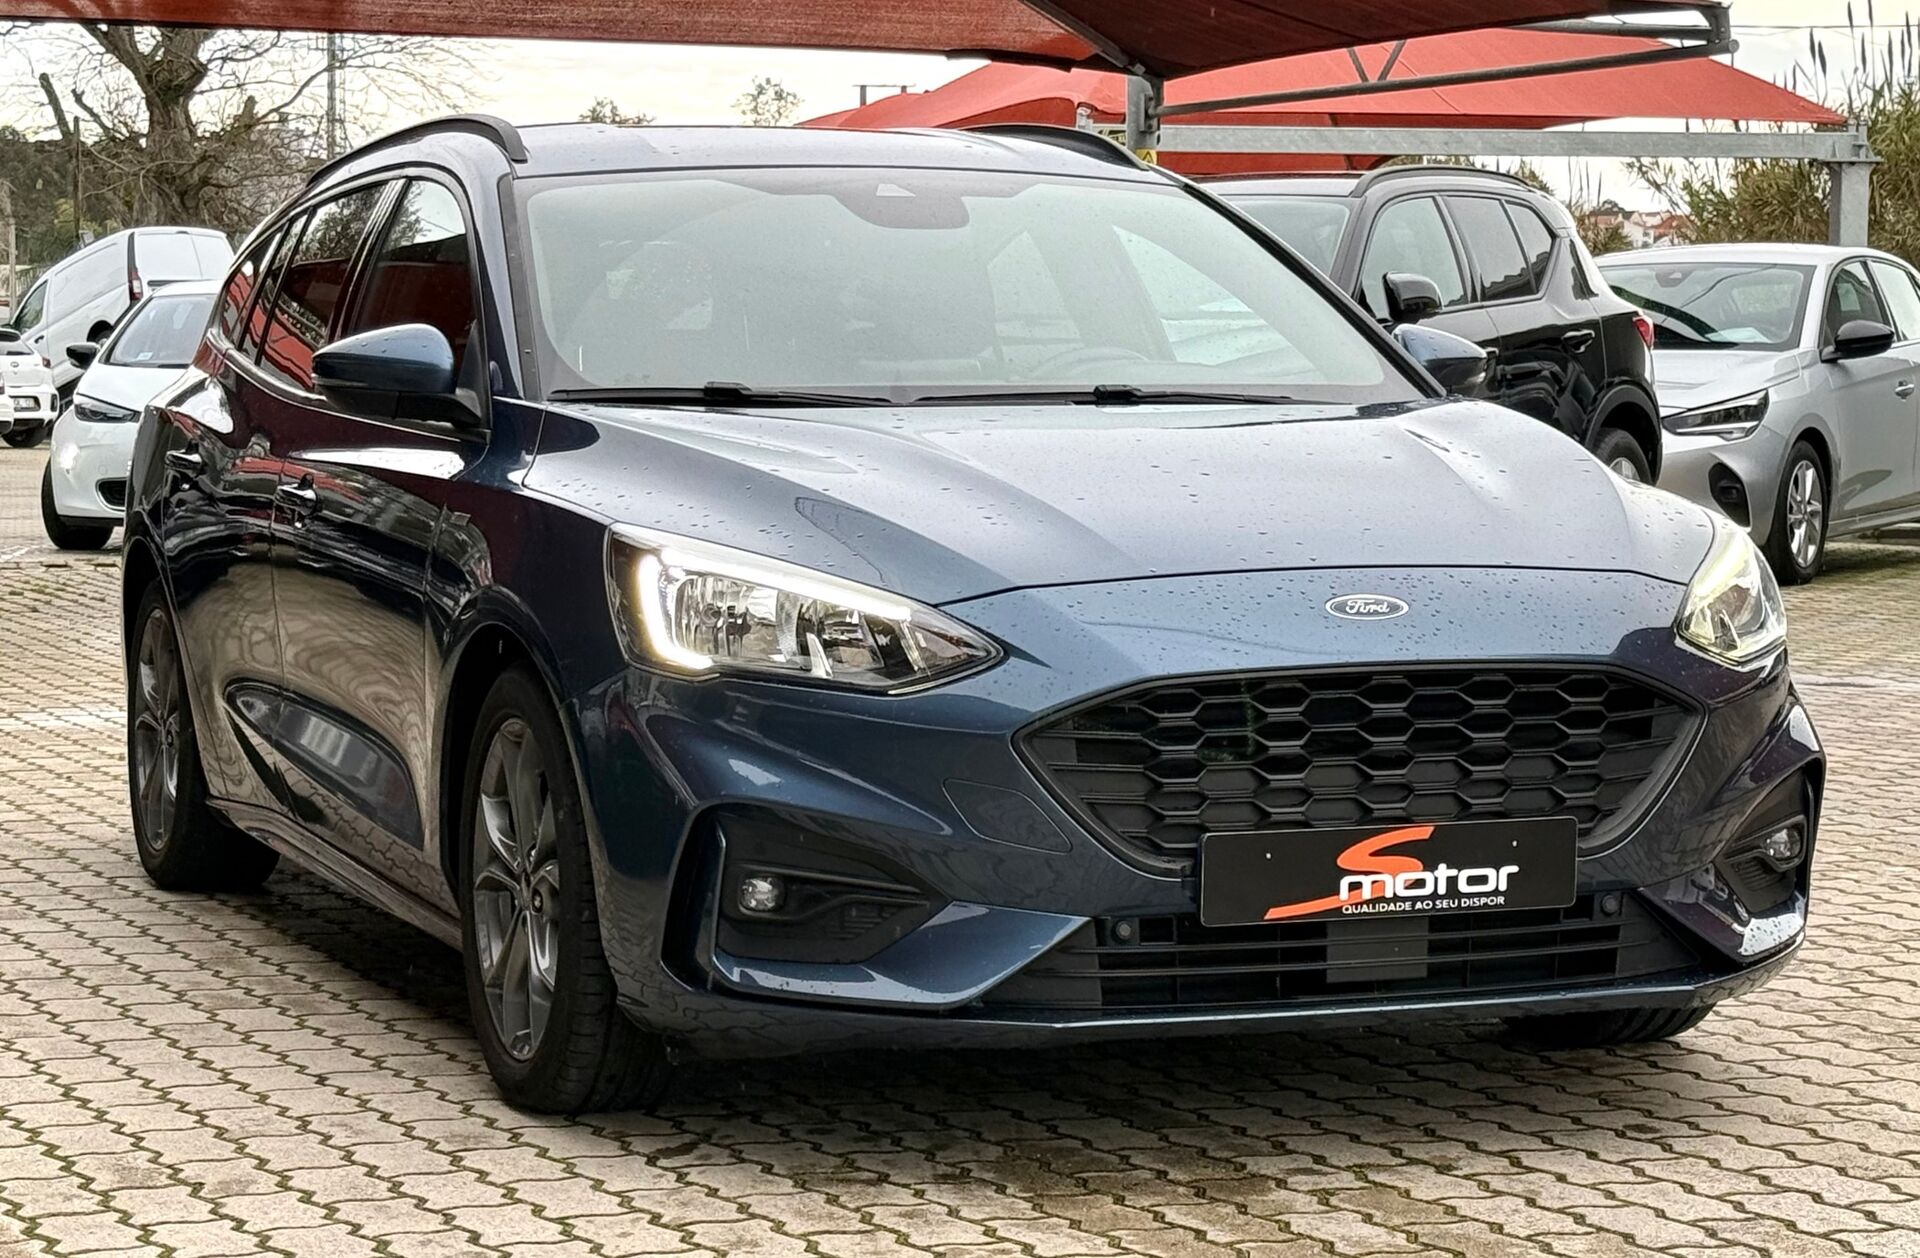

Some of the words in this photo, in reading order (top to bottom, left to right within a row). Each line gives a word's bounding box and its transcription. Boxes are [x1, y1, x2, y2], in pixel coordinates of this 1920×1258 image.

[1345, 599, 1391, 613] Ford
[1342, 901, 1412, 914] QUALIDADE
[1414, 900, 1433, 910] AO
[1435, 898, 1459, 908] SEU
[1461, 895, 1505, 907] DISPOR
